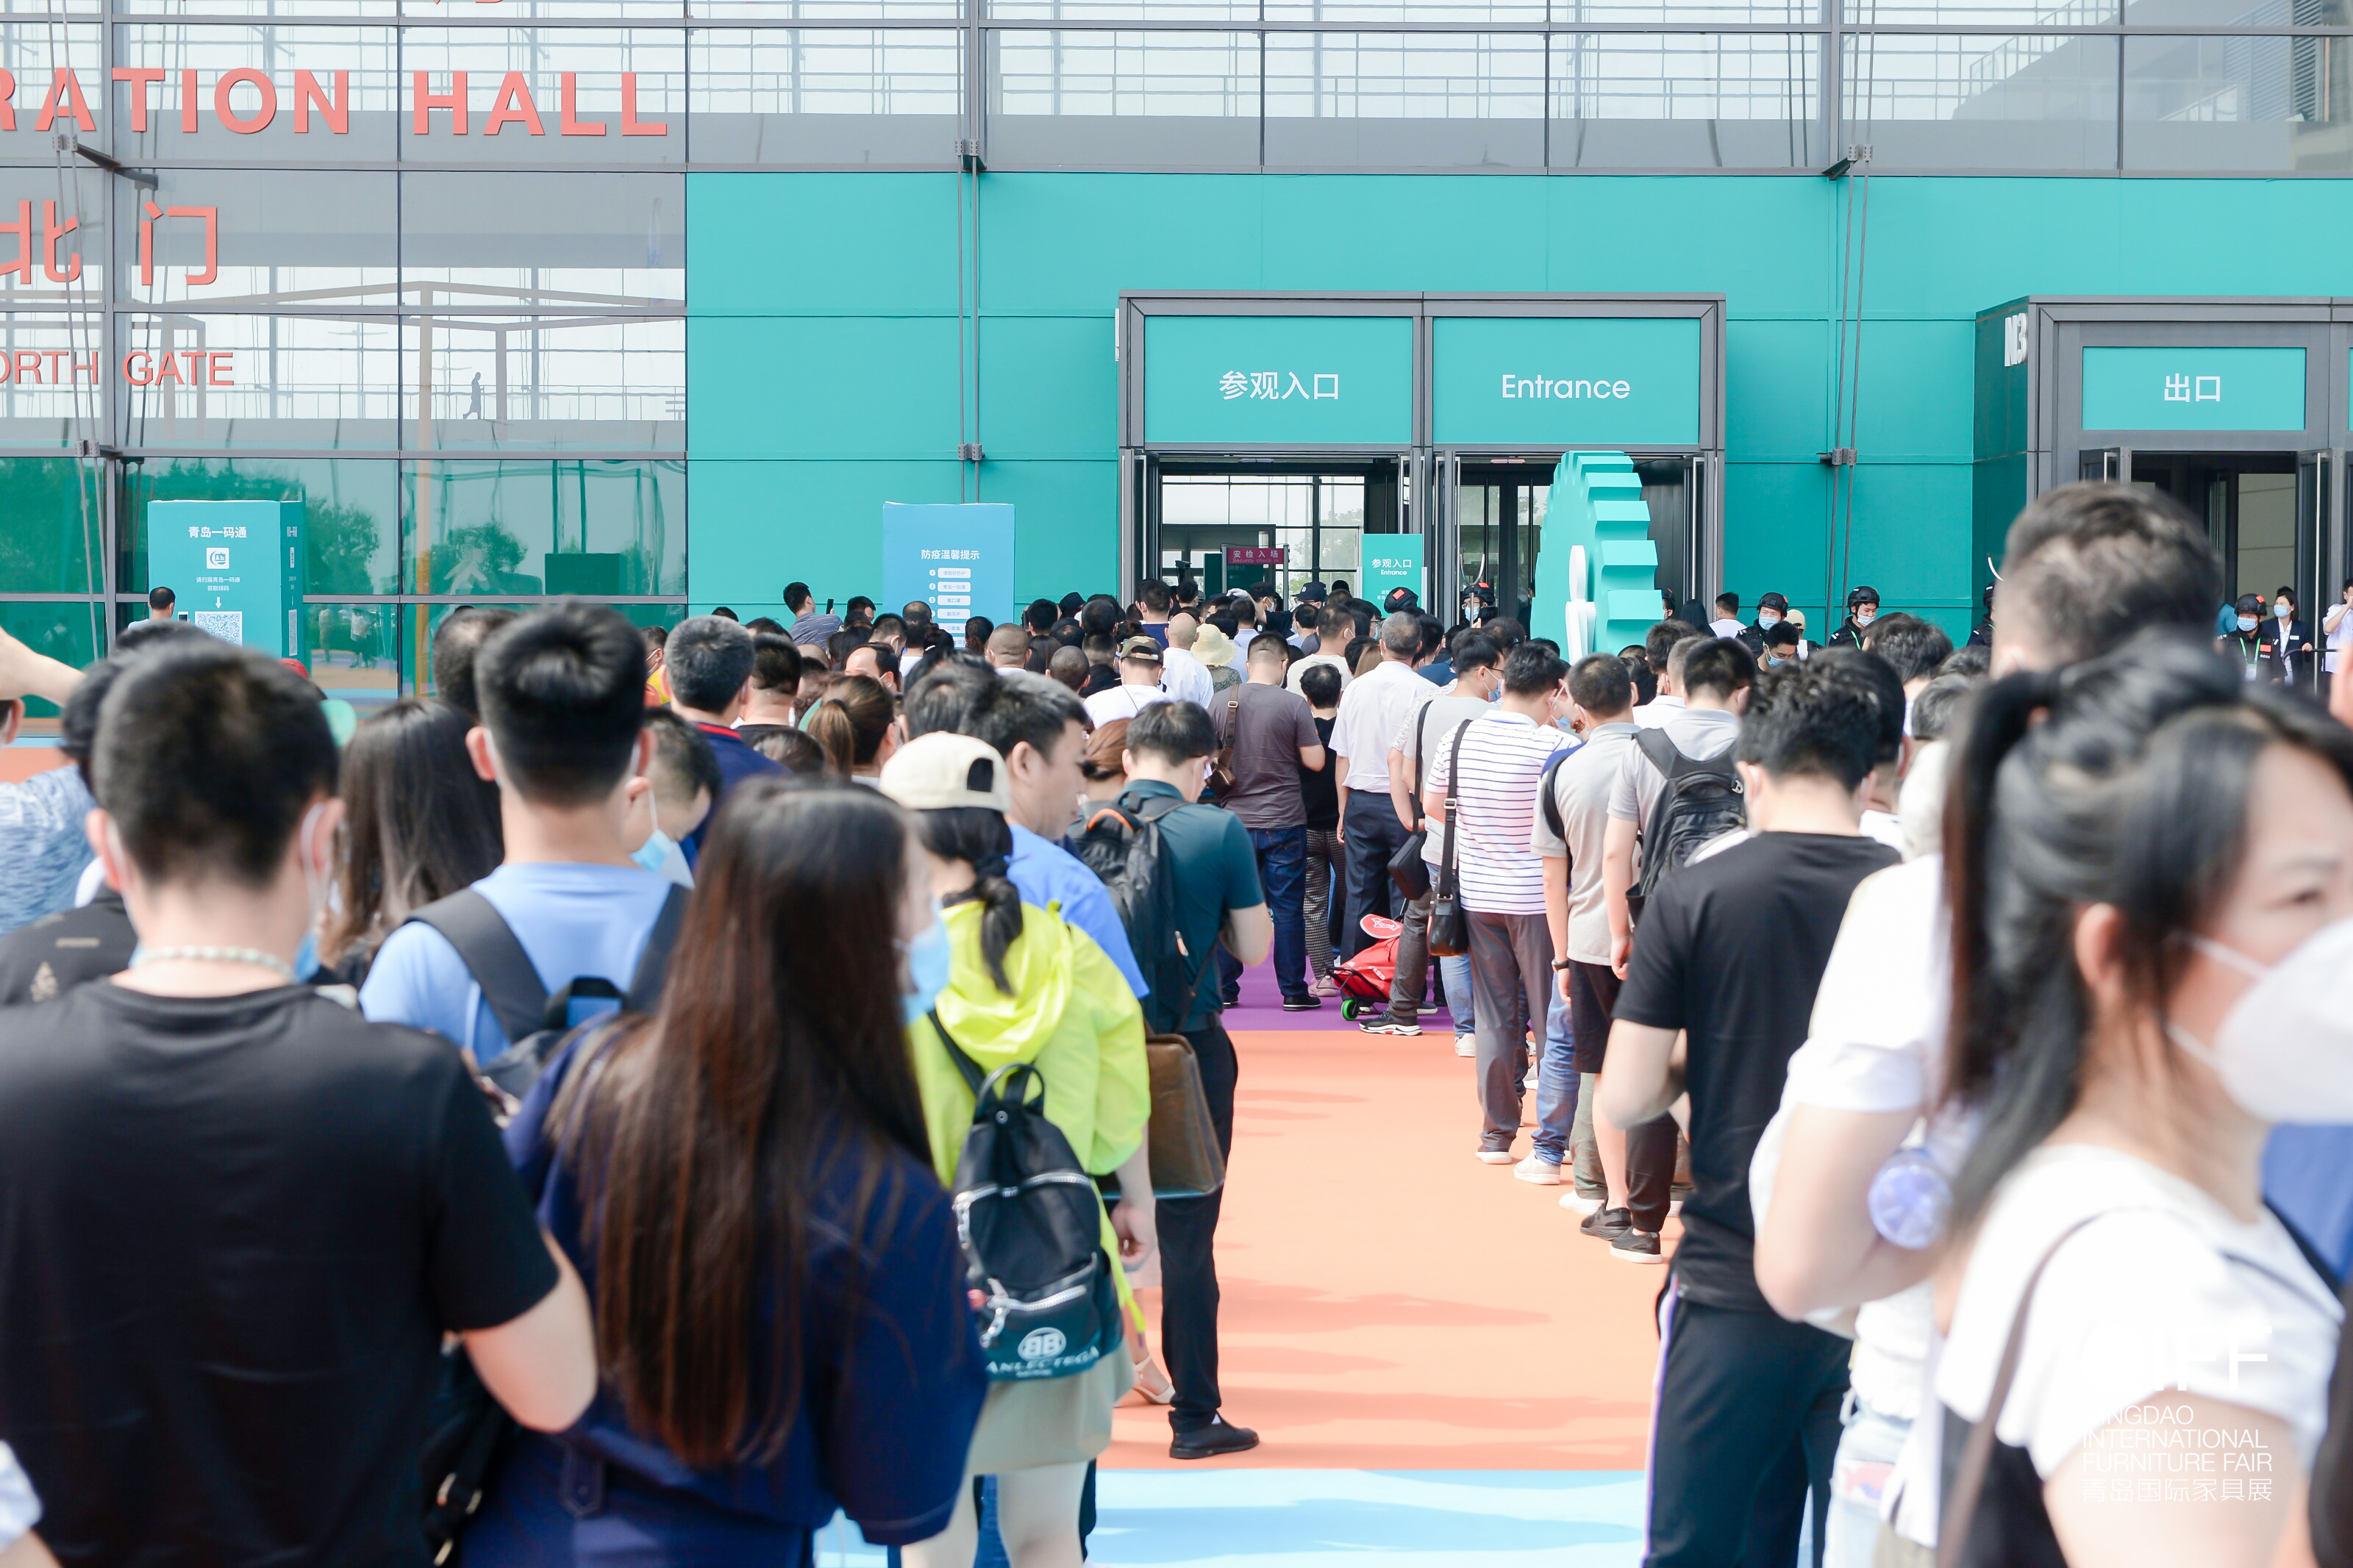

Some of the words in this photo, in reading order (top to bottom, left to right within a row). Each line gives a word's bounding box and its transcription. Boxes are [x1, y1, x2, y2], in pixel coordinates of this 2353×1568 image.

[413, 71, 668, 136] HALL
[0, 200, 218, 286] 北门
[2004, 313, 2027, 366] N3
[123, 351, 234, 386] GATE
[1218, 370, 1340, 401] 参观入口
[1502, 373, 1630, 399] Entrance
[2164, 373, 2221, 403] 出口
[188, 526, 247, 538] 青岛一码通
[921, 549, 980, 560] 防疫温馨提示
[1233, 550, 1279, 558] 安检入场
[1371, 558, 1412, 568] 参观入口
